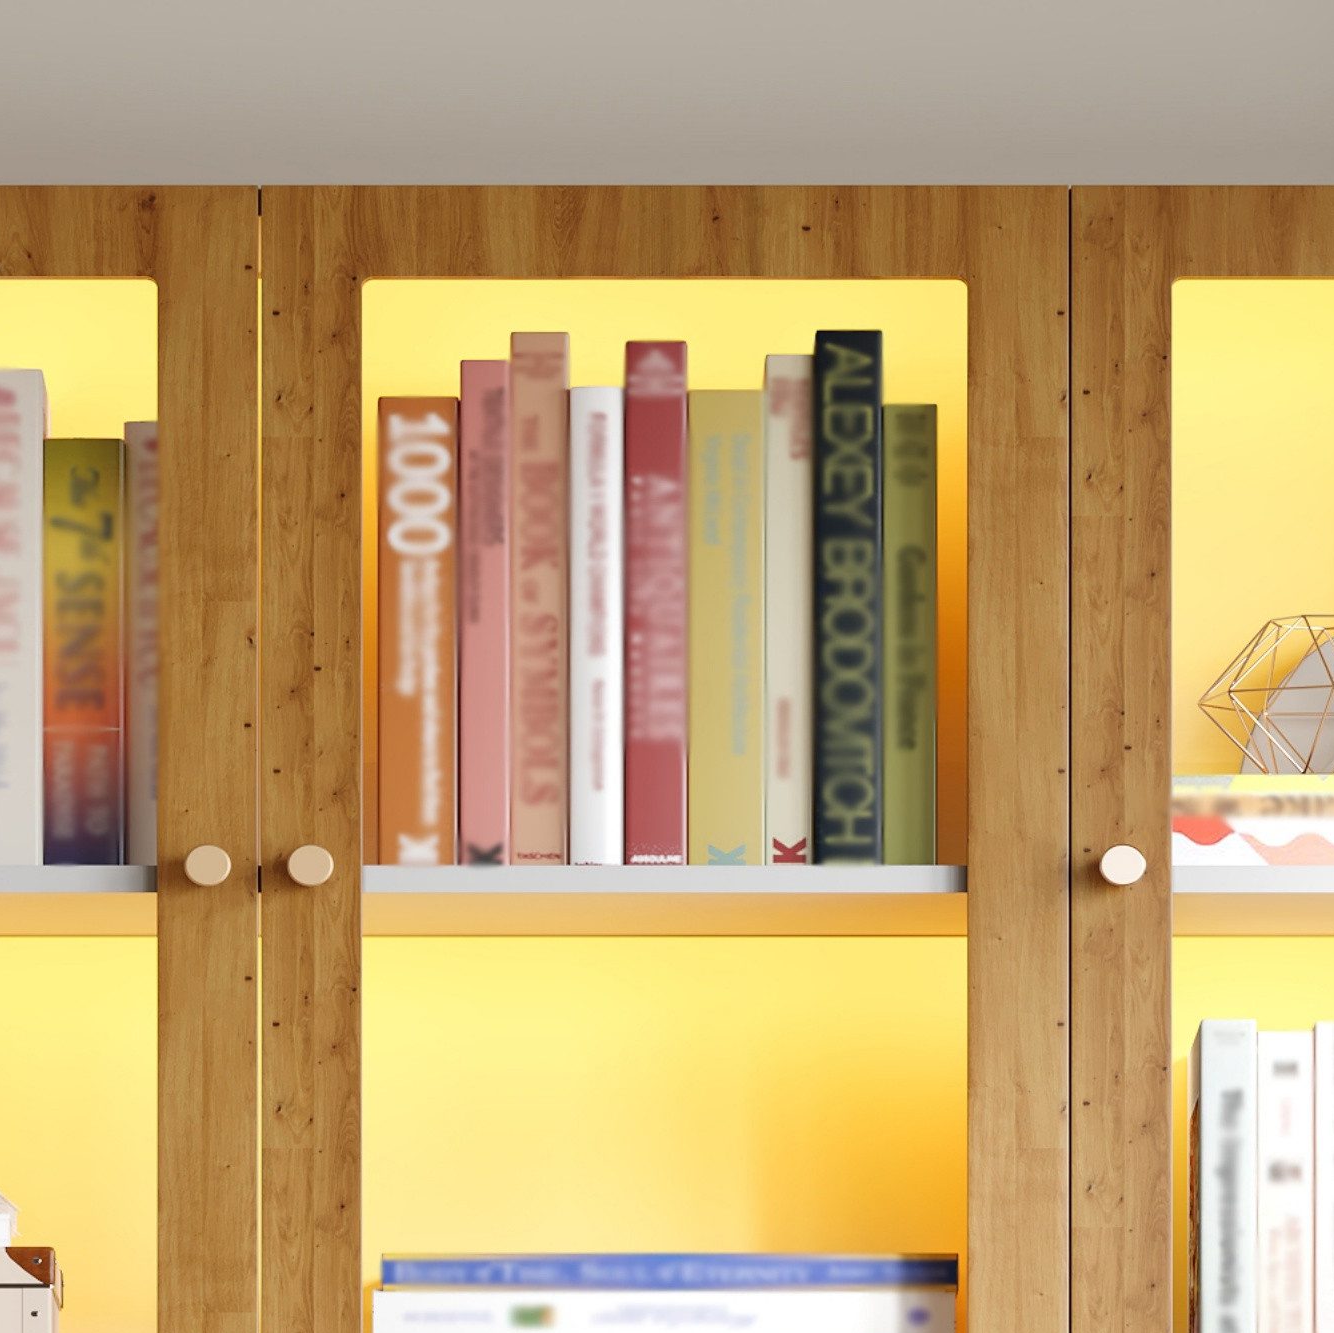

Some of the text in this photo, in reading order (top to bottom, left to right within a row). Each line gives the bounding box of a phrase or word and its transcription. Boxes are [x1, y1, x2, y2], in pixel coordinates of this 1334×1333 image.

[386, 412, 453, 556] 1000
[520, 458, 558, 572] BOOK
[55, 571, 106, 711] SENSE
[823, 342, 874, 846] ALEXEY BRODOVITCH
[518, 613, 559, 807] SYMBOLS
